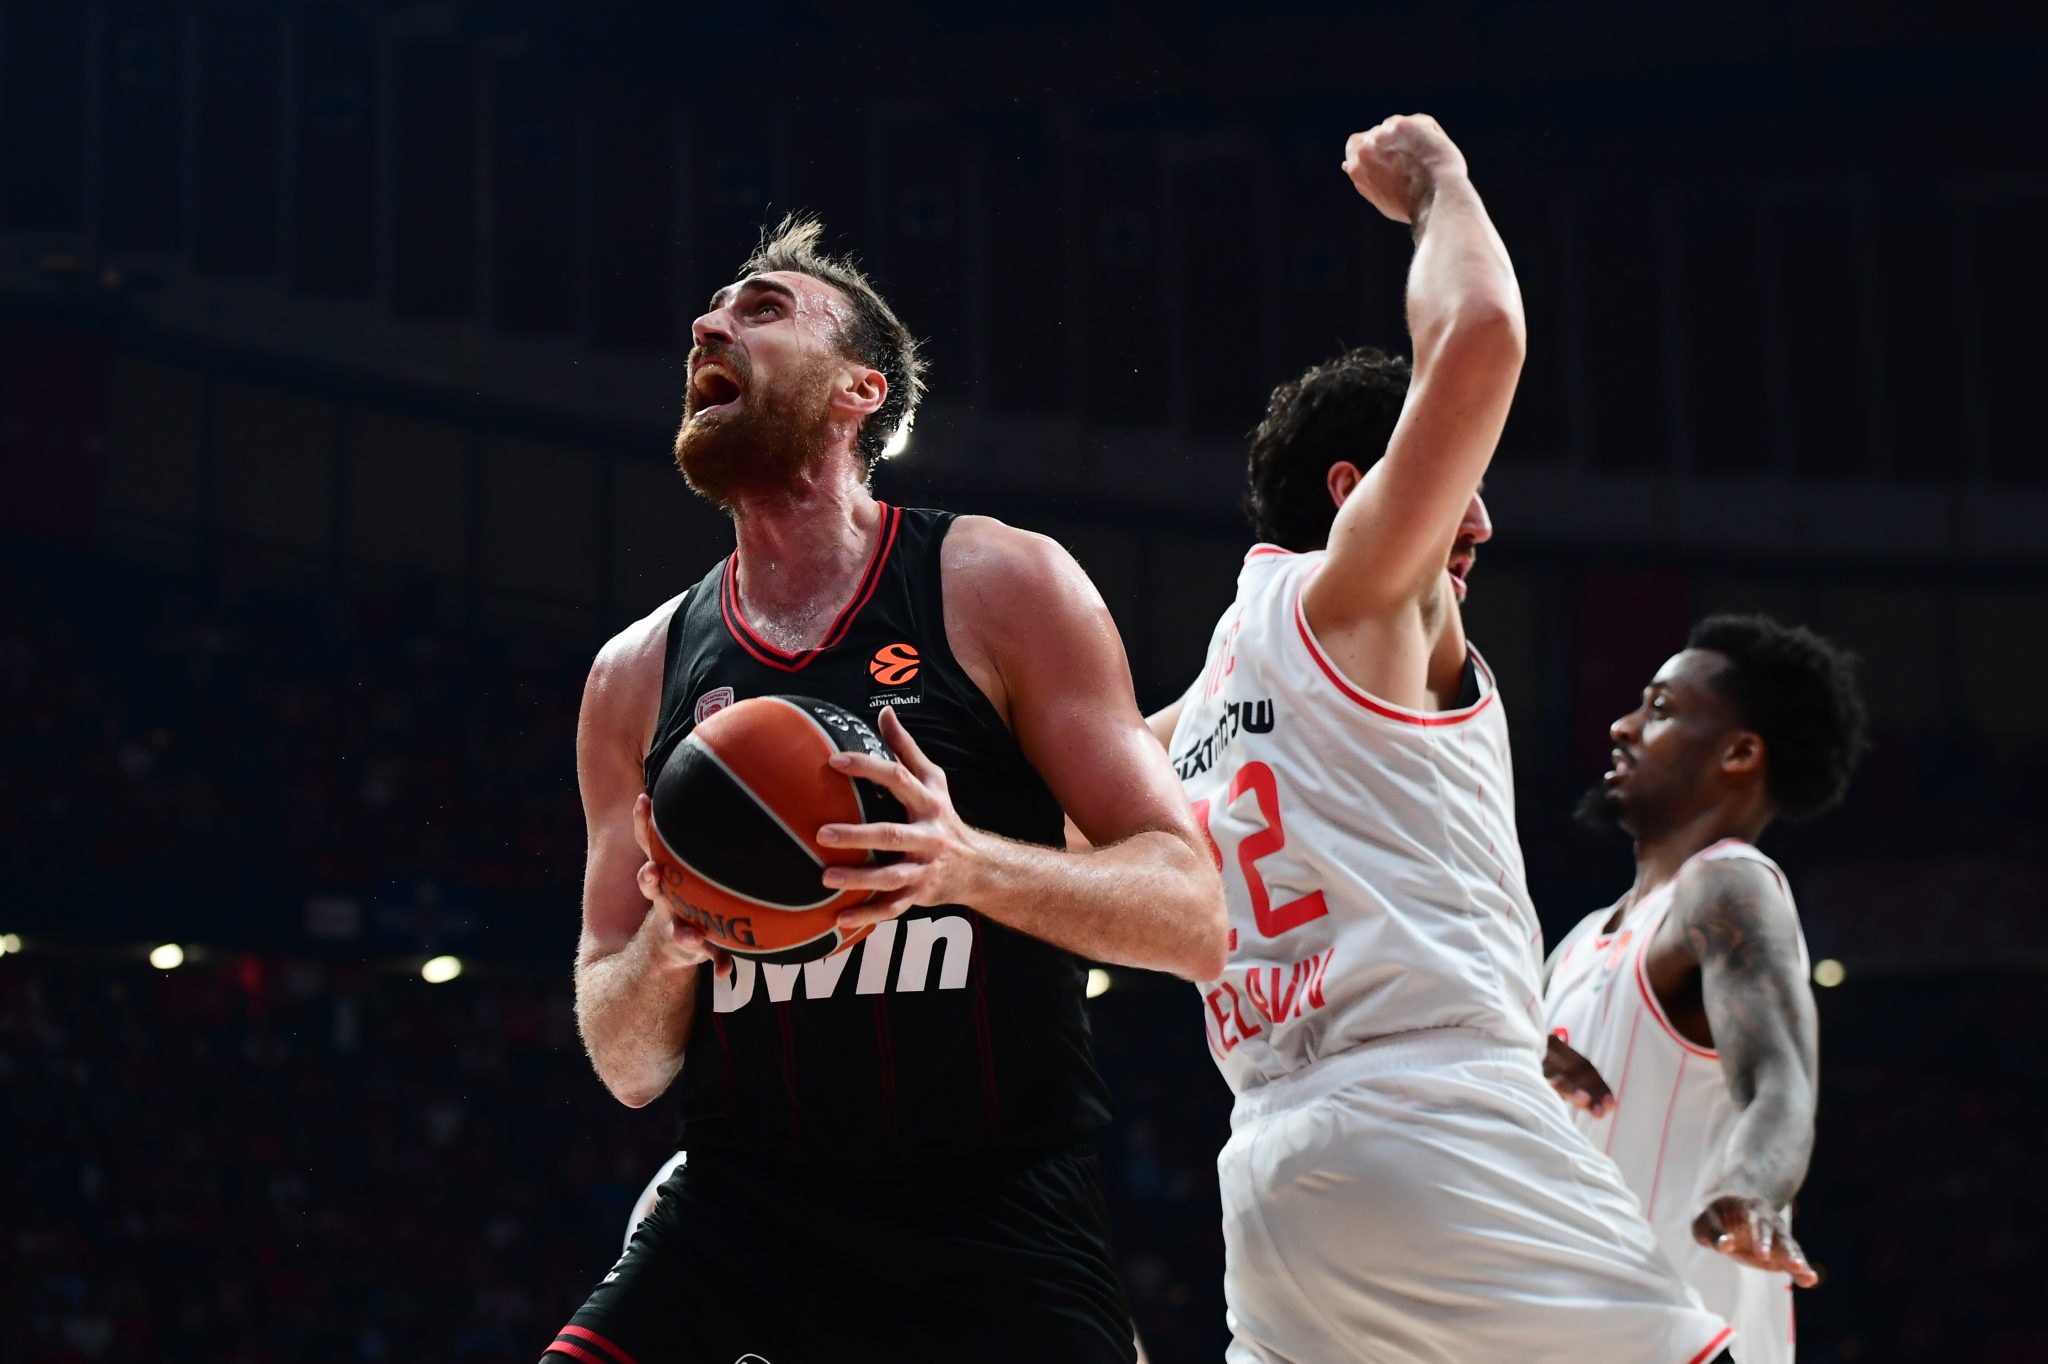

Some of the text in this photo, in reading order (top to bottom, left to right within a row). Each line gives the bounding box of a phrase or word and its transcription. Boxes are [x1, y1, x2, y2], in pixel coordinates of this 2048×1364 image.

[869, 694, 921, 708] abu dhabi
[1205, 948, 1335, 1061] EL AVIV
